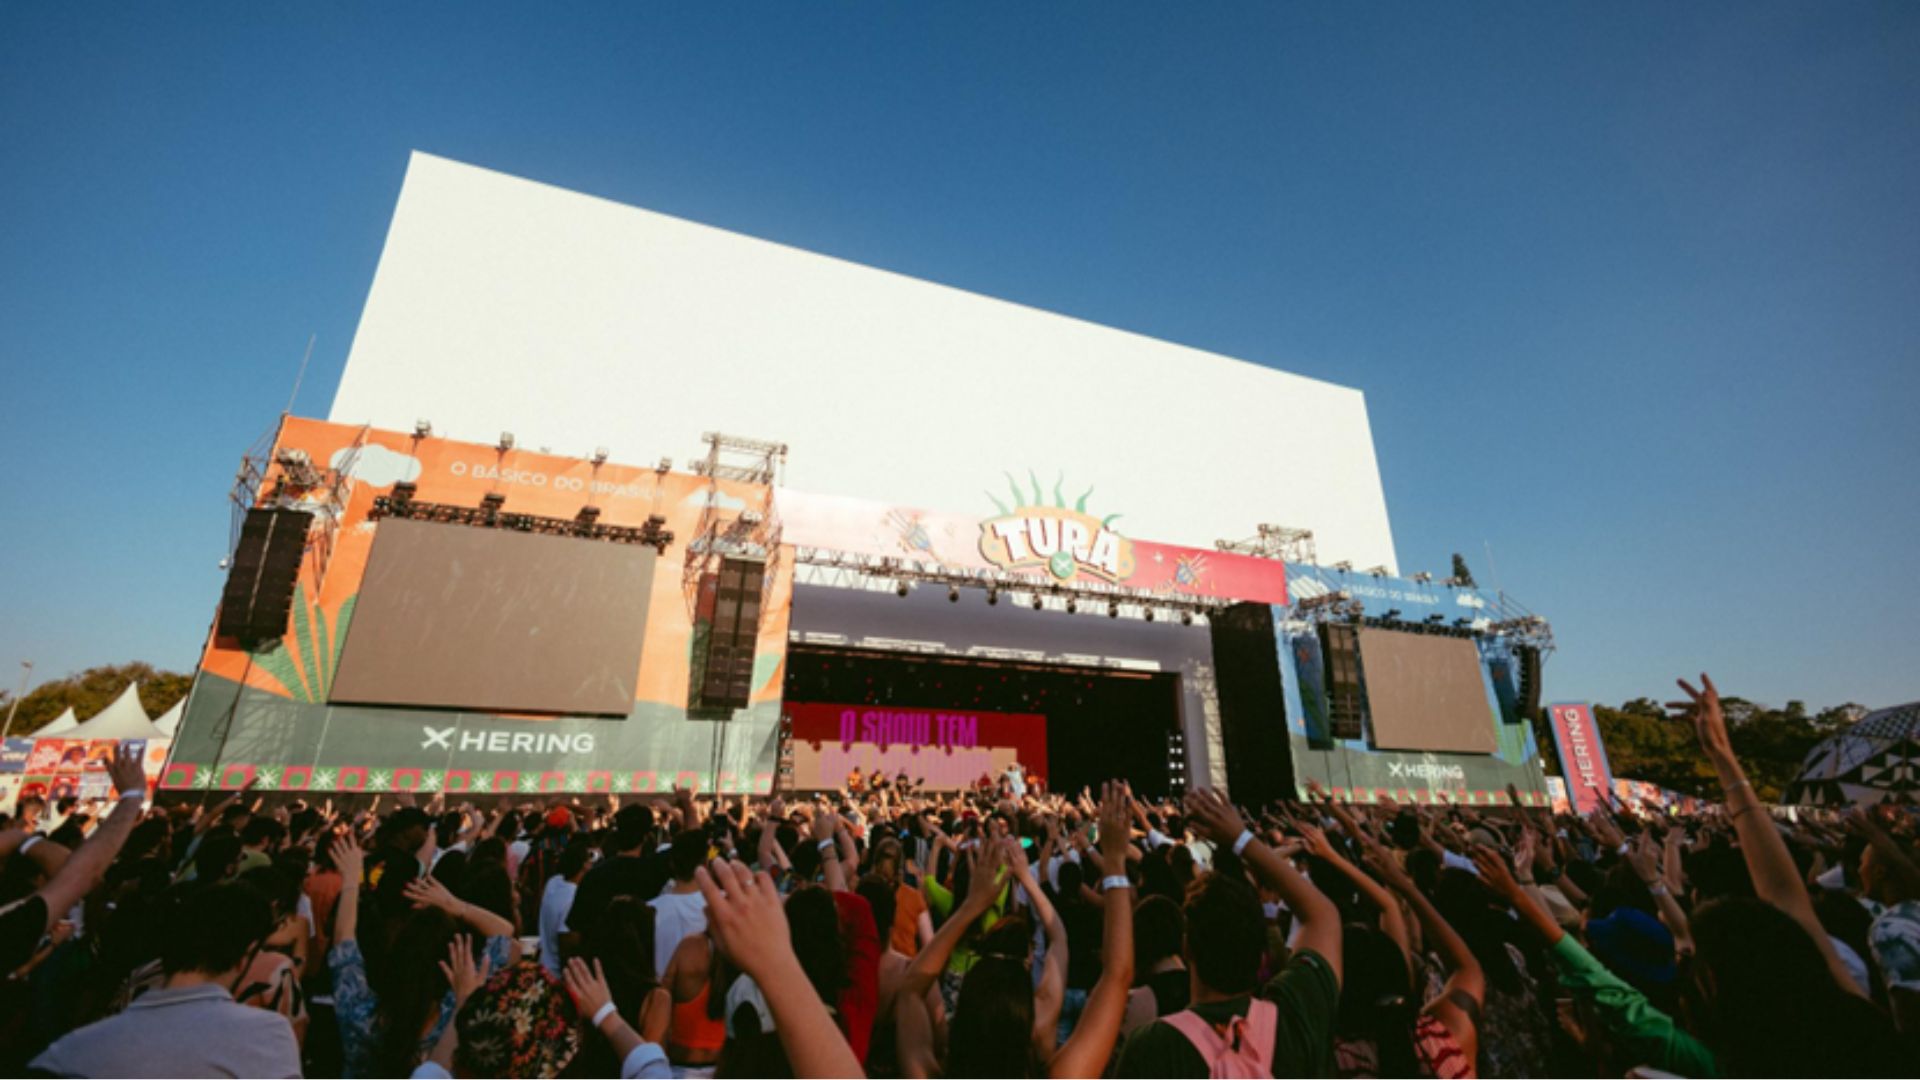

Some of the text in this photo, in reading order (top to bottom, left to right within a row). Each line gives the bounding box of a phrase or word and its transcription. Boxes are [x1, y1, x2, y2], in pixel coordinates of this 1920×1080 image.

[451, 460, 468, 477] O
[472, 463, 548, 487] BÁSICO
[553, 474, 584, 492] DO
[459, 730, 595, 754] HERING
[840, 710, 857, 744] O
[1564, 708, 1598, 787] HERING
